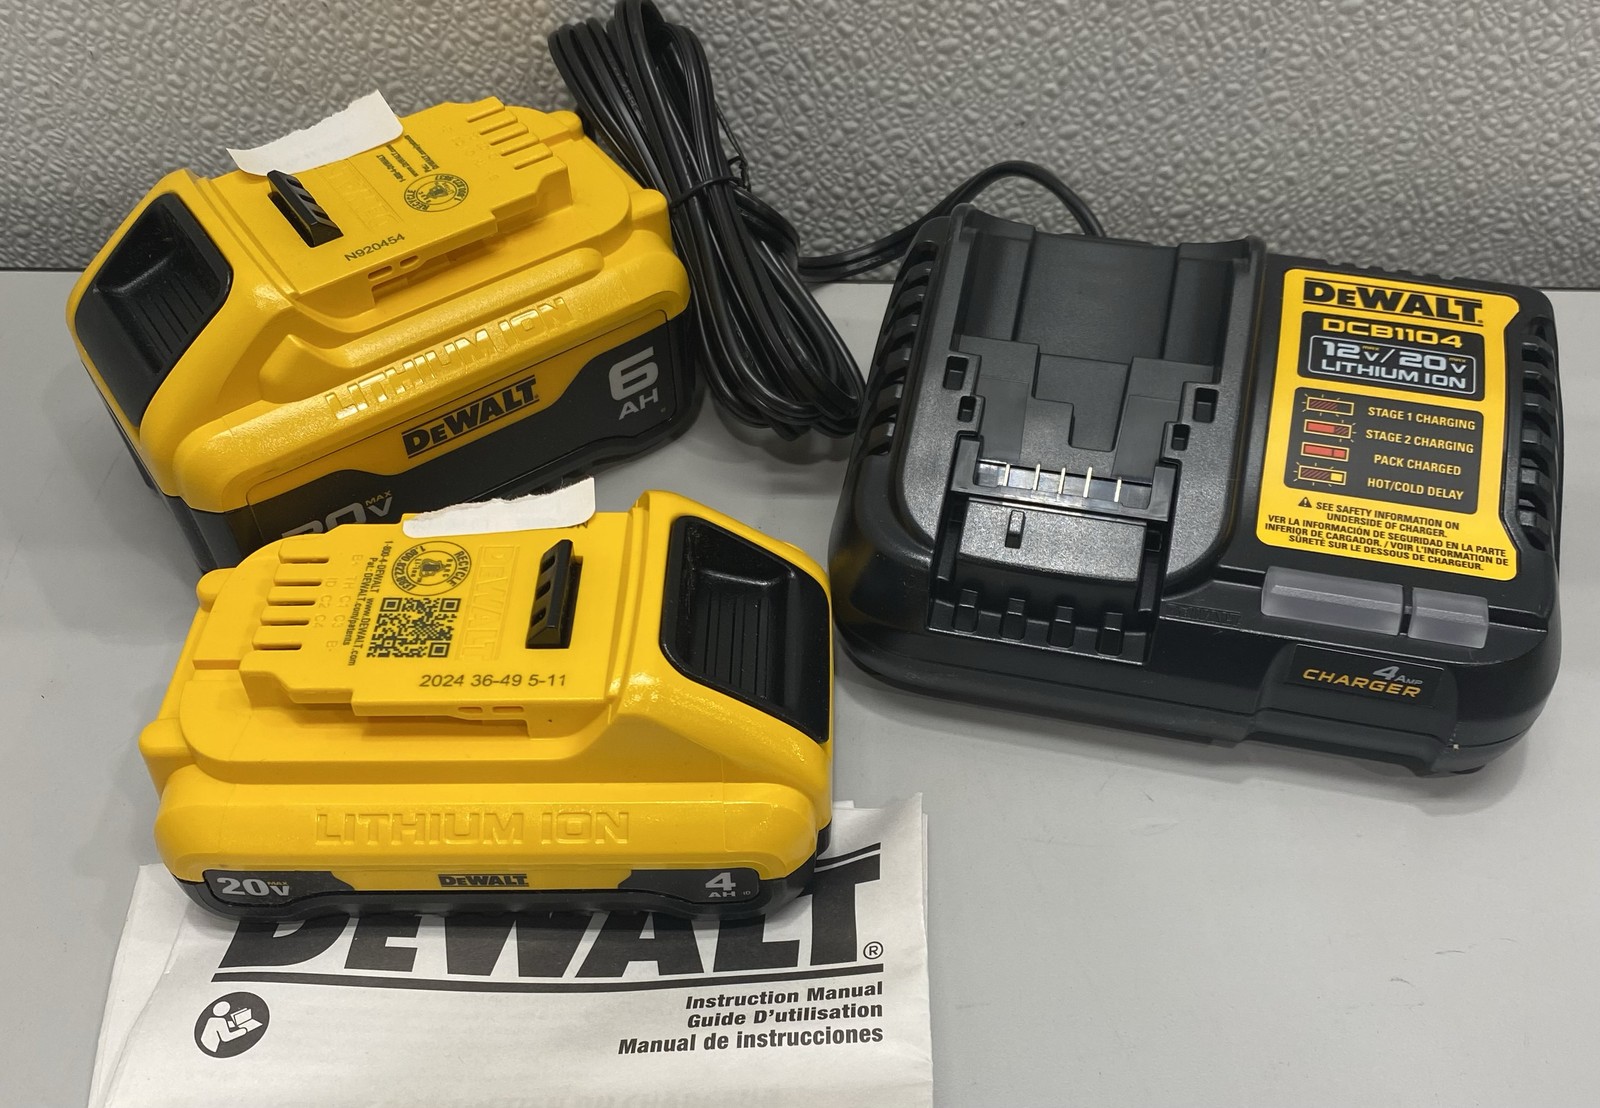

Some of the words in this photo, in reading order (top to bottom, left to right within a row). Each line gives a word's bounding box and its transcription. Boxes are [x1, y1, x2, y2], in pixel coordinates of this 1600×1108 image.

[344, 233, 405, 261] N920454
[1322, 318, 1463, 348] DCB1104
[325, 329, 499, 420] LITHIUM
[498, 297, 574, 343] ION
[607, 347, 659, 401] 6
[1321, 359, 1418, 382] LITHIUM
[1425, 373, 1466, 389] ION
[618, 388, 658, 420] AH
[1367, 406, 1404, 420] STAGE
[1407, 412, 1412, 421] 1
[1415, 413, 1476, 431] CHARGING
[1365, 429, 1402, 443] STAGE
[1404, 435, 1411, 445] 2
[1413, 436, 1474, 454] CHARGING
[1373, 454, 1404, 468] PACK
[1407, 459, 1461, 476] CHARGED
[365, 489, 392, 506] MAX
[1367, 477, 1424, 495] HOT/COLD
[1427, 486, 1464, 500] DELAY
[1316, 501, 1334, 511] SEE
[1336, 504, 1372, 517] SAFETY
[1374, 510, 1442, 528] INFORMATION
[1445, 521, 1459, 530] ON
[1327, 513, 1382, 528] UNDERSIDE
[1384, 521, 1397, 529] OF
[1399, 523, 1447, 538] CHARGER.
[1265, 523, 1308, 536] INFERIOR
[1310, 529, 1323, 538] DE
[1325, 532, 1382, 547] CARGADOR.
[1390, 541, 1413, 552] VOIR
[1416, 545, 1493, 564] L'INFORMATION
[1496, 557, 1508, 566] DE
[1268, 514, 1286, 524] VER
[1288, 517, 1299, 526] LA
[1302, 519, 1370, 537] INFORMACIÓN
[1373, 530, 1385, 539] DE
[1388, 532, 1443, 547] SEGURIDAD
[1446, 541, 1459, 550] EN
[1461, 543, 1473, 552] LA
[1476, 545, 1506, 557] PARTE
[446, 550, 470, 587] RECYCLE
[1328, 540, 1348, 550] SUR
[1350, 543, 1361, 552] LE
[1363, 546, 1410, 560] DESSOUS
[1412, 553, 1425, 562] DE
[1427, 556, 1484, 571] CHARGEUR.
[419, 673, 465, 687] 2024
[470, 673, 523, 687] 36-49
[528, 673, 566, 687] 5-11
[1303, 668, 1421, 698] CHARGER
[315, 811, 525, 845] LITHIUM
[541, 811, 630, 845] ION
[217, 877, 290, 896] 20V
[705, 871, 736, 891] 4
[685, 990, 799, 1010] Instruction
[806, 981, 883, 1002] Manual
[687, 1012, 746, 1028] Guide
[753, 1003, 883, 1025] D'utilisation
[618, 1034, 696, 1055] Manual
[703, 1032, 729, 1051] de
[736, 1027, 884, 1049] instrucciones
